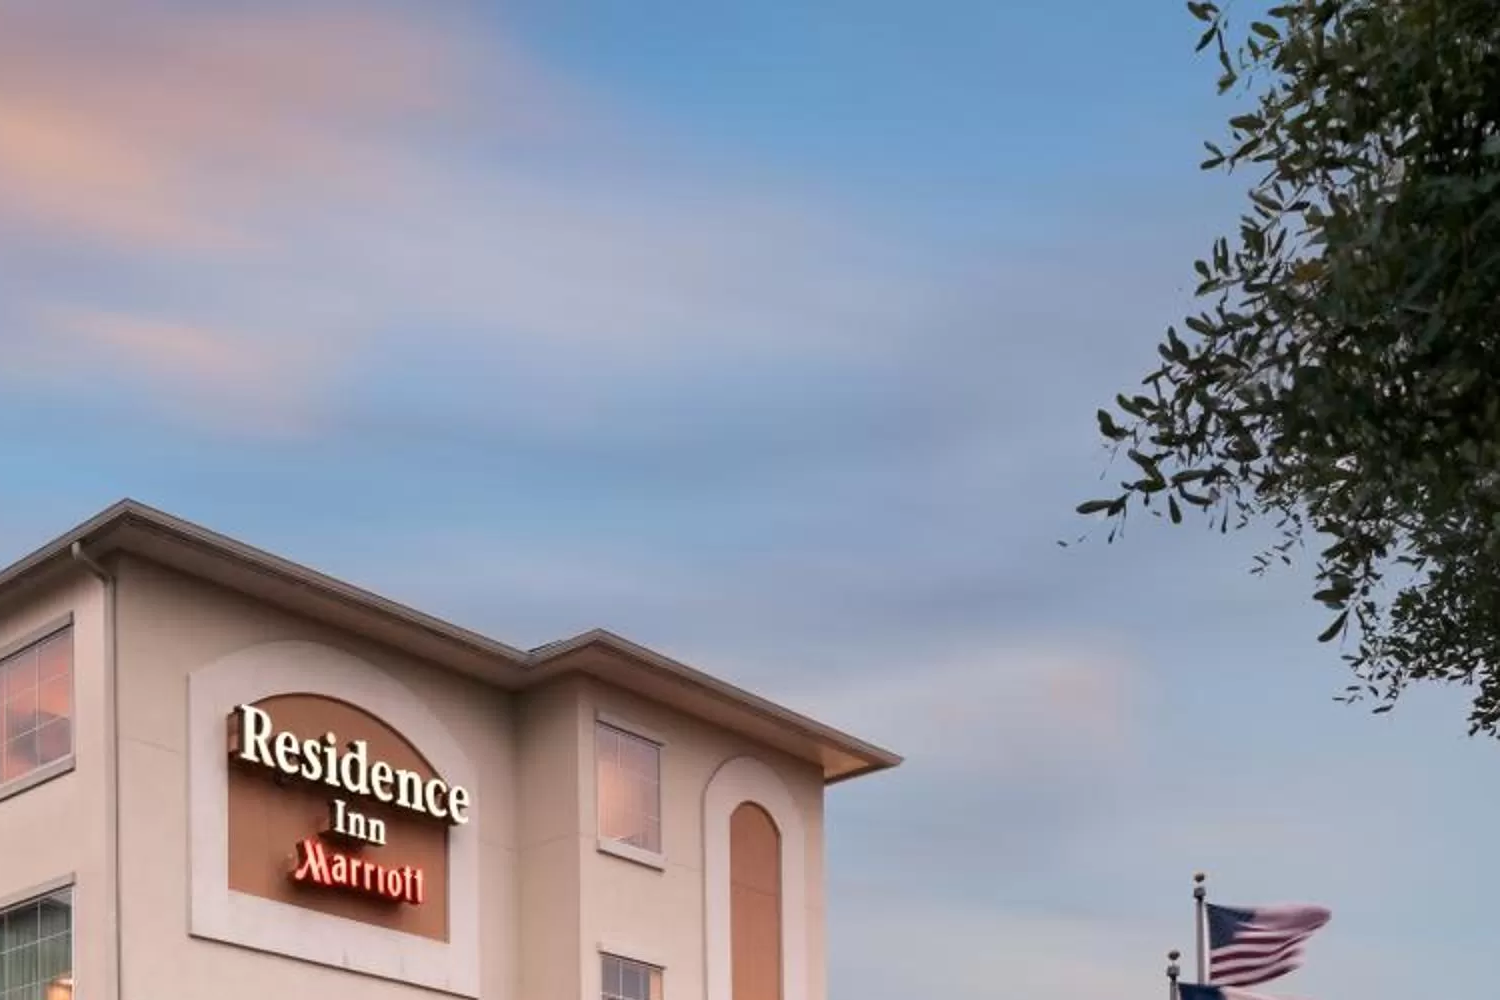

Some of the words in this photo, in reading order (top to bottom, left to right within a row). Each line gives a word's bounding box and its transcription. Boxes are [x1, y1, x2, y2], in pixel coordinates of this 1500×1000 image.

[240, 703, 469, 823] Residence
[333, 799, 387, 845] Inn
[295, 839, 423, 903] Marriott
